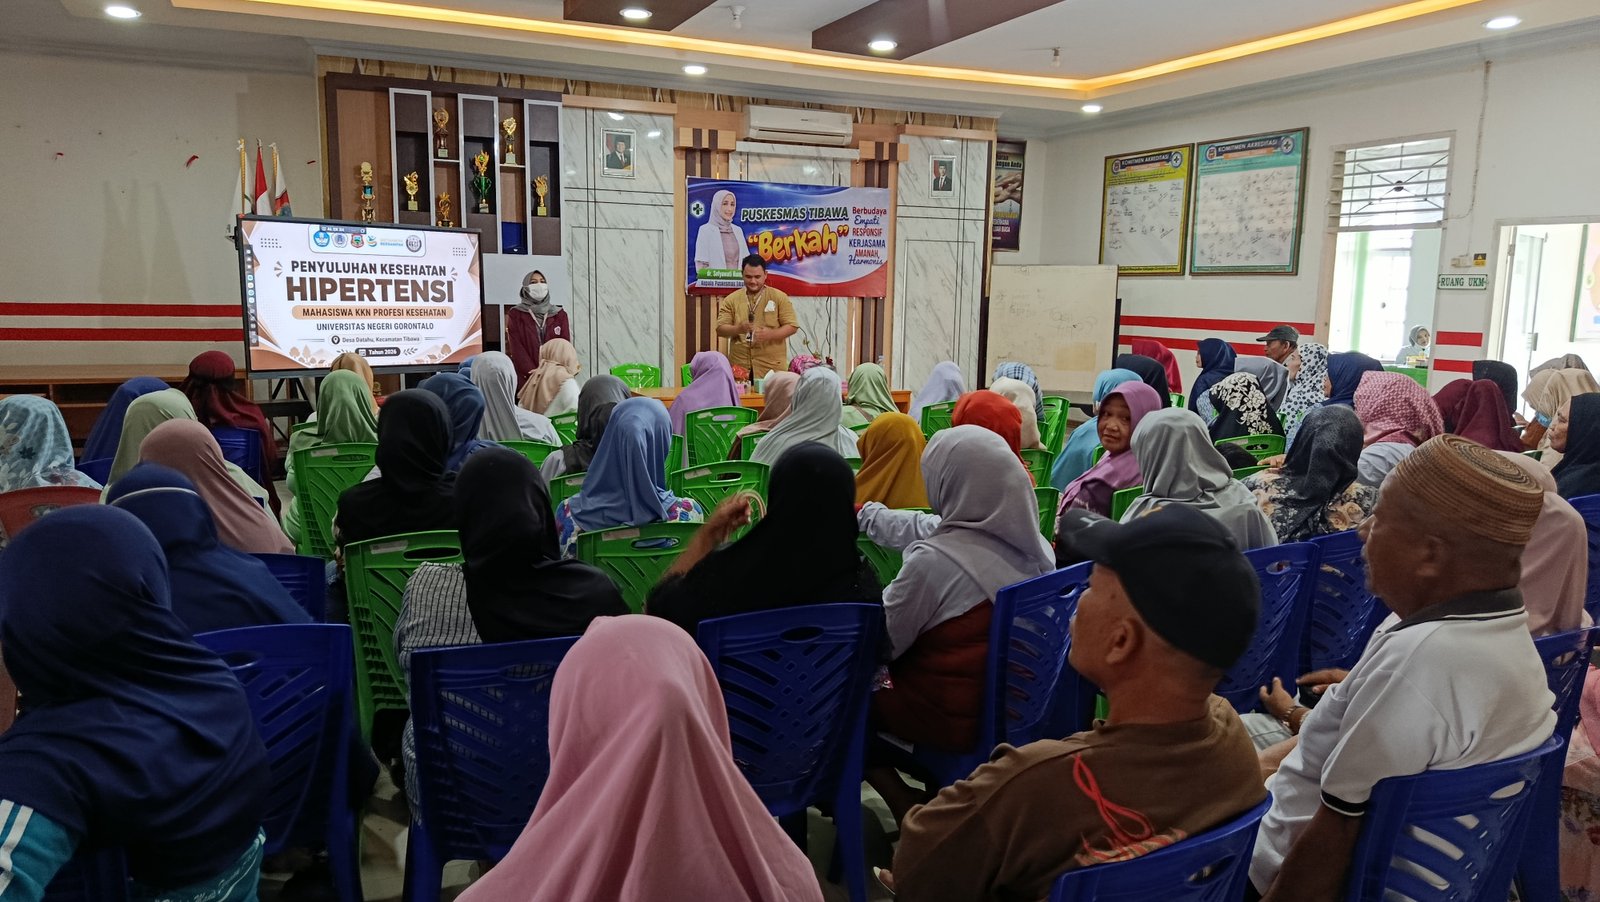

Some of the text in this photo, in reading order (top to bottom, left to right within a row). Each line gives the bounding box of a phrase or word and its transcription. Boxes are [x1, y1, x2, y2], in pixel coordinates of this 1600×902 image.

[741, 206, 849, 221] PUSKESMAS TIBAWA
[852, 206, 887, 217] Berbudaya
[854, 215, 880, 228] Empati
[852, 227, 883, 237] RESPONSIF
[849, 239, 886, 247] KERJASAMA
[848, 254, 883, 265] Harmonis
[291, 260, 447, 277] PENYULUHAN KESEHATAN
[1440, 277, 1485, 287] RUANG UKM
[285, 276, 455, 303] HIPERTENSI
[302, 308, 447, 317] MAHASISWA KKN PROFESI KESEHATAN
[316, 322, 434, 331] UNIVERSITAS NEGERI GORONTALO
[355, 336, 375, 344] Datahu,
[375, 335, 403, 343] Kecamatan
